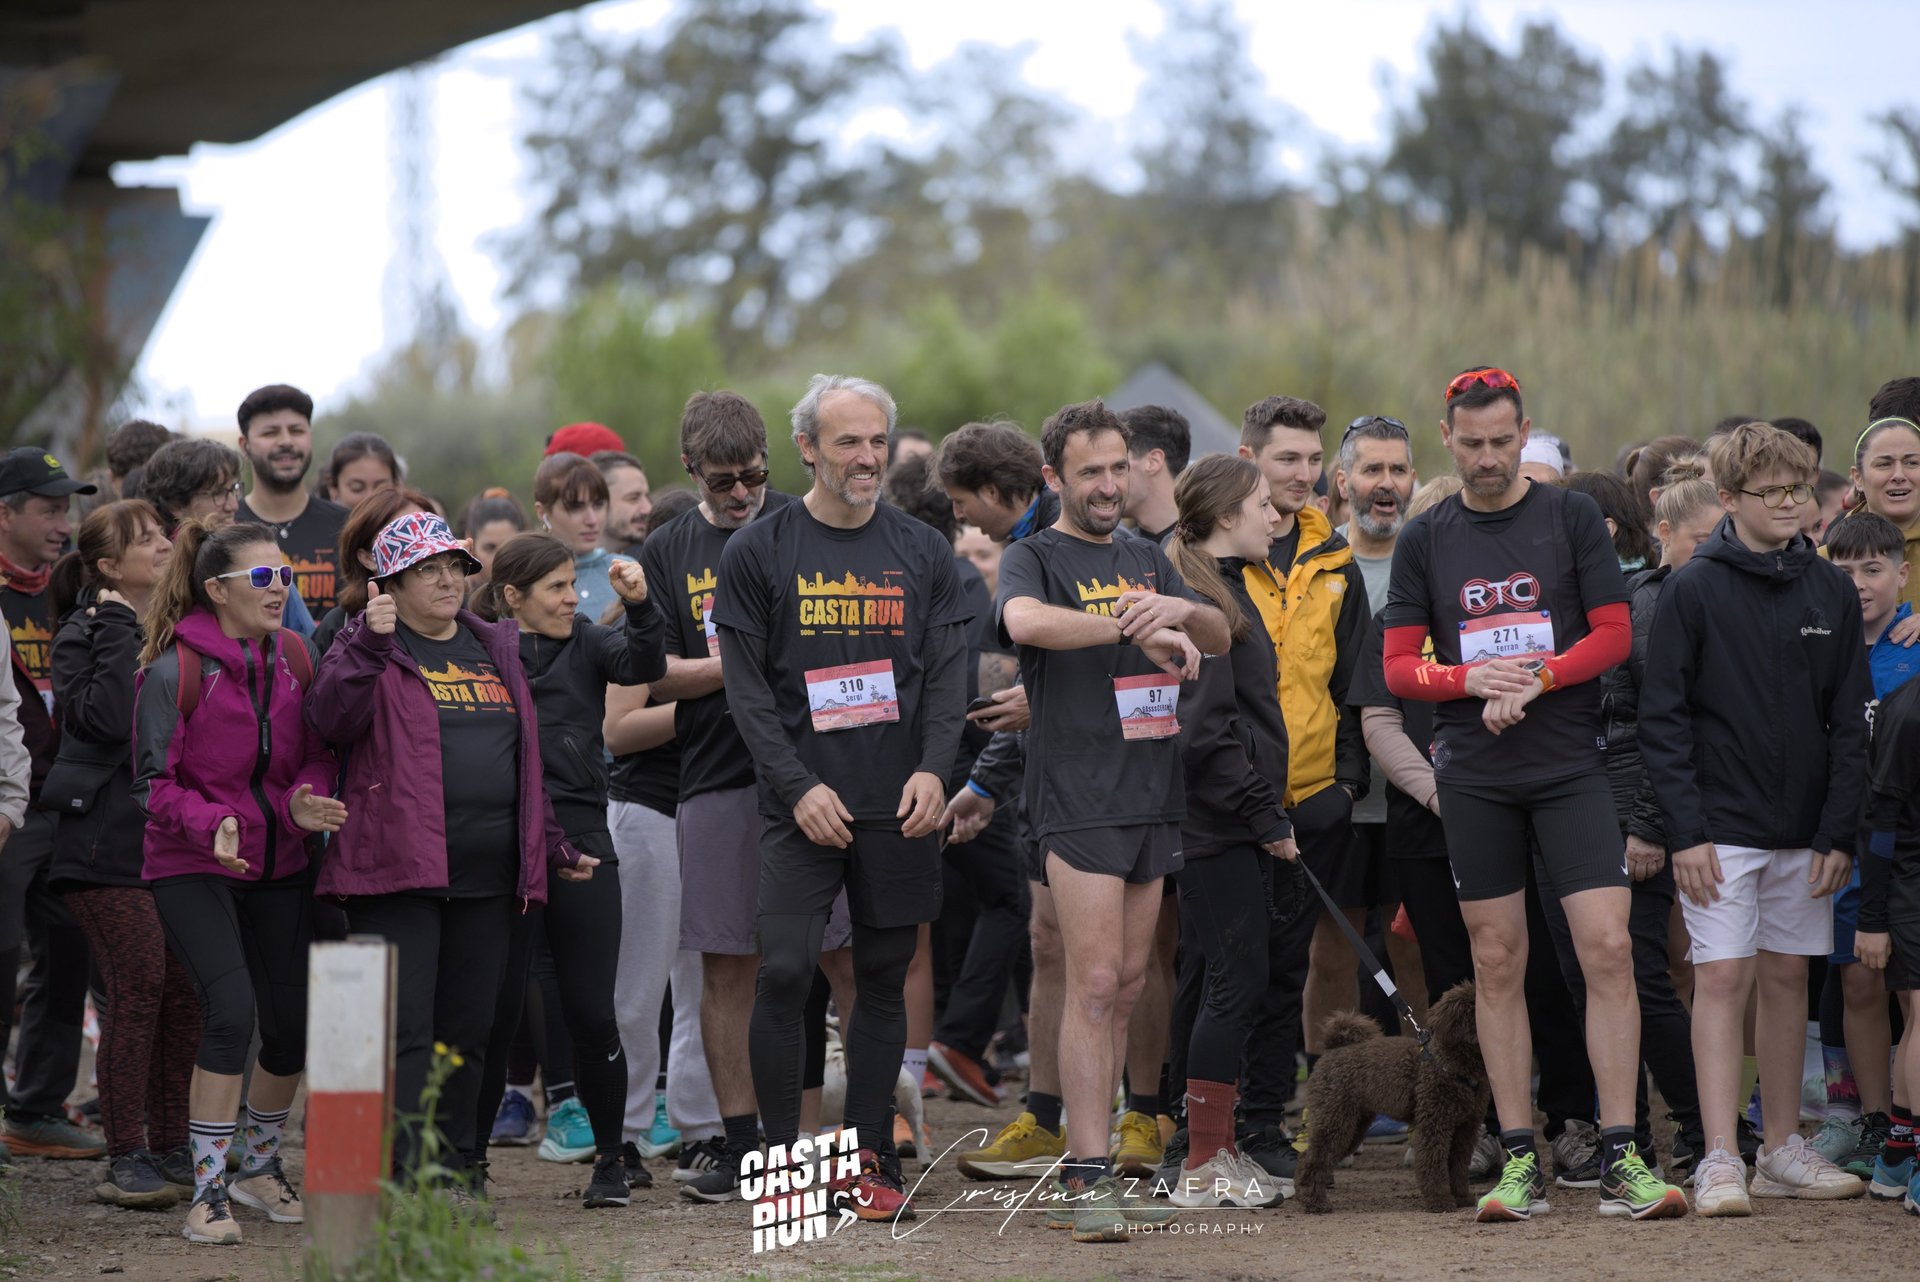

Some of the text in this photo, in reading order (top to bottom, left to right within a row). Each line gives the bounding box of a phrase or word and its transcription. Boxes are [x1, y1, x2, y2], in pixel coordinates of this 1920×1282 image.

[297, 573, 336, 599] RUN
[1464, 578, 1535, 610] RTC
[800, 599, 904, 625] CASTA RUN
[1493, 627, 1519, 644] 271
[1496, 643, 1520, 653] Ferran
[427, 681, 475, 703] ASTA
[839, 678, 864, 694] 310
[845, 693, 863, 702] Sergi
[1149, 689, 1162, 703] 97
